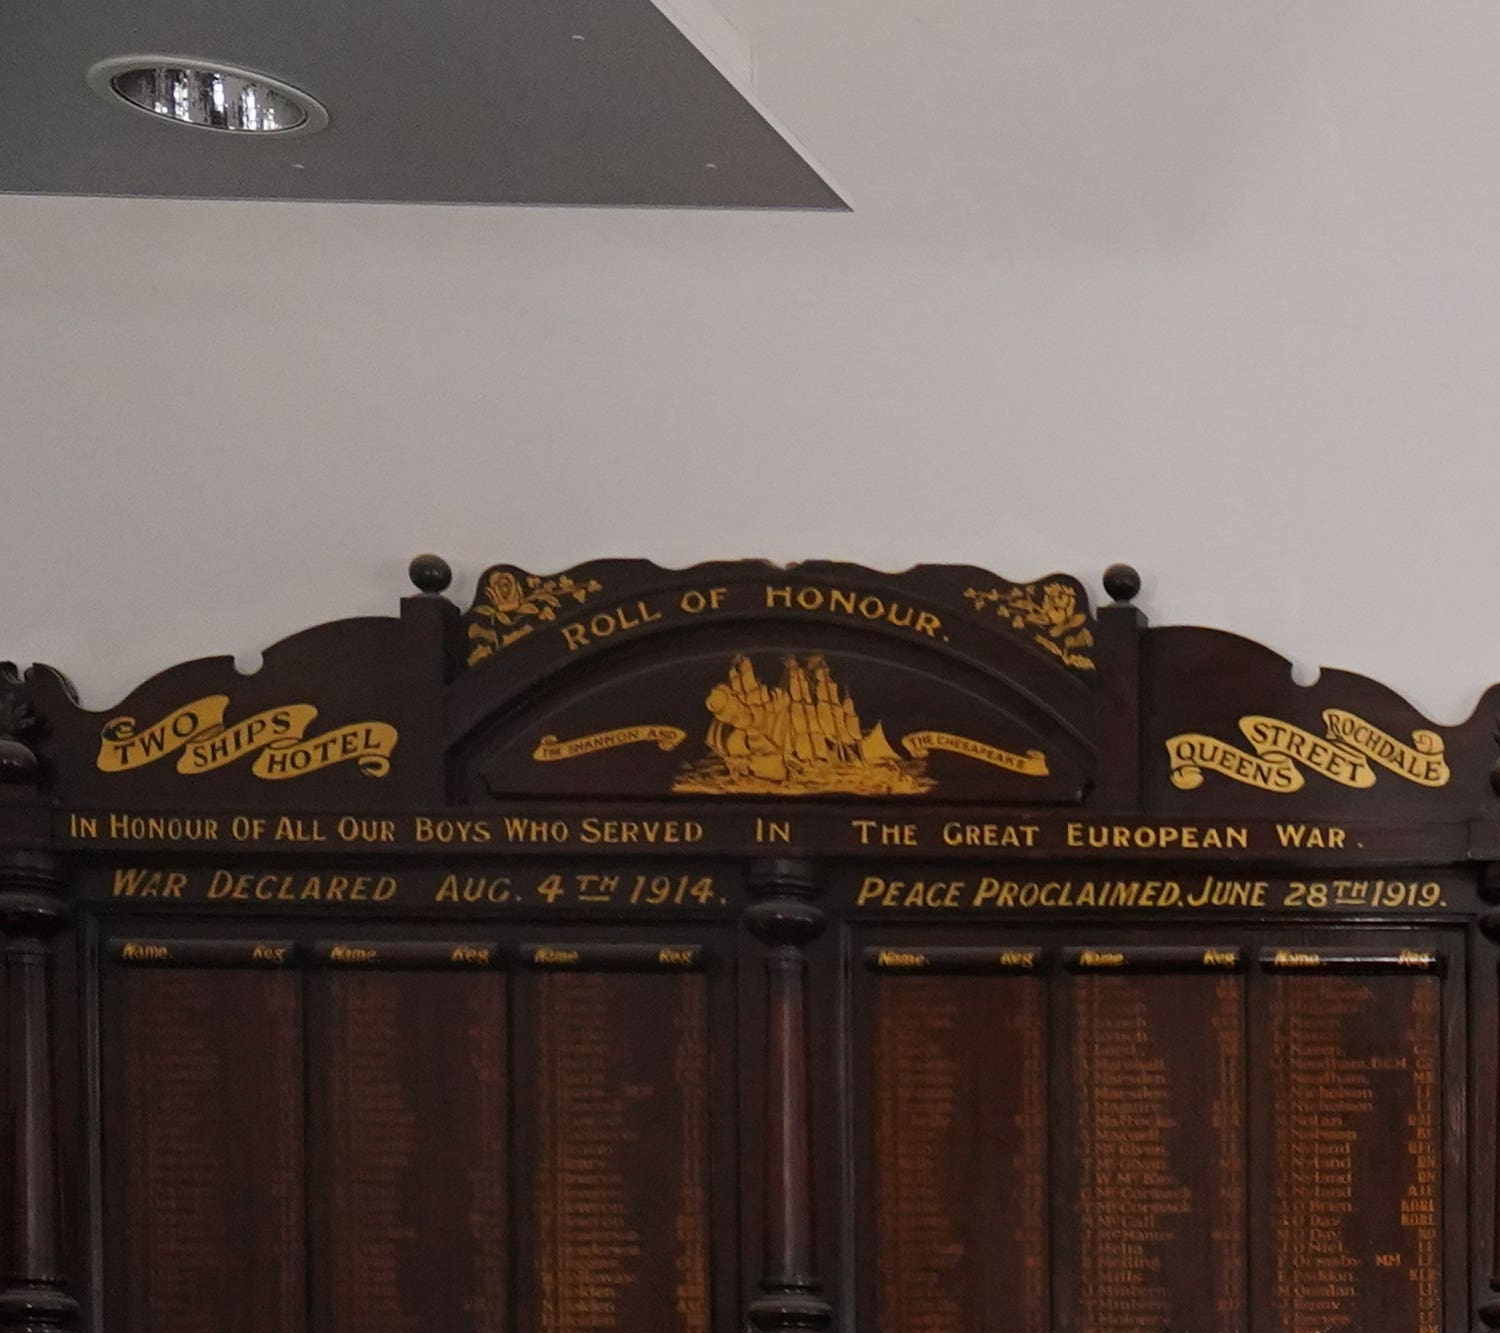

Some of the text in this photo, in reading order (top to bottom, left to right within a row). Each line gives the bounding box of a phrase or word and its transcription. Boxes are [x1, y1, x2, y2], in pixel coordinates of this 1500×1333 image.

[561, 602, 661, 650] ROLL
[681, 589, 726, 612] OF
[114, 710, 382, 774] TWO SHIPS HOTEL
[1176, 713, 1441, 788] QUEENS STREET ROCHDALE
[72, 815, 1247, 848] IN HONOUR OF ALL OUR BOYS WHO SERVED IN THE GREAT EUROPEAN
[114, 870, 187, 897] WAR
[208, 871, 396, 900] DECLARED
[858, 878, 964, 906] PEACE
[1187, 877, 1268, 906] JUNE
